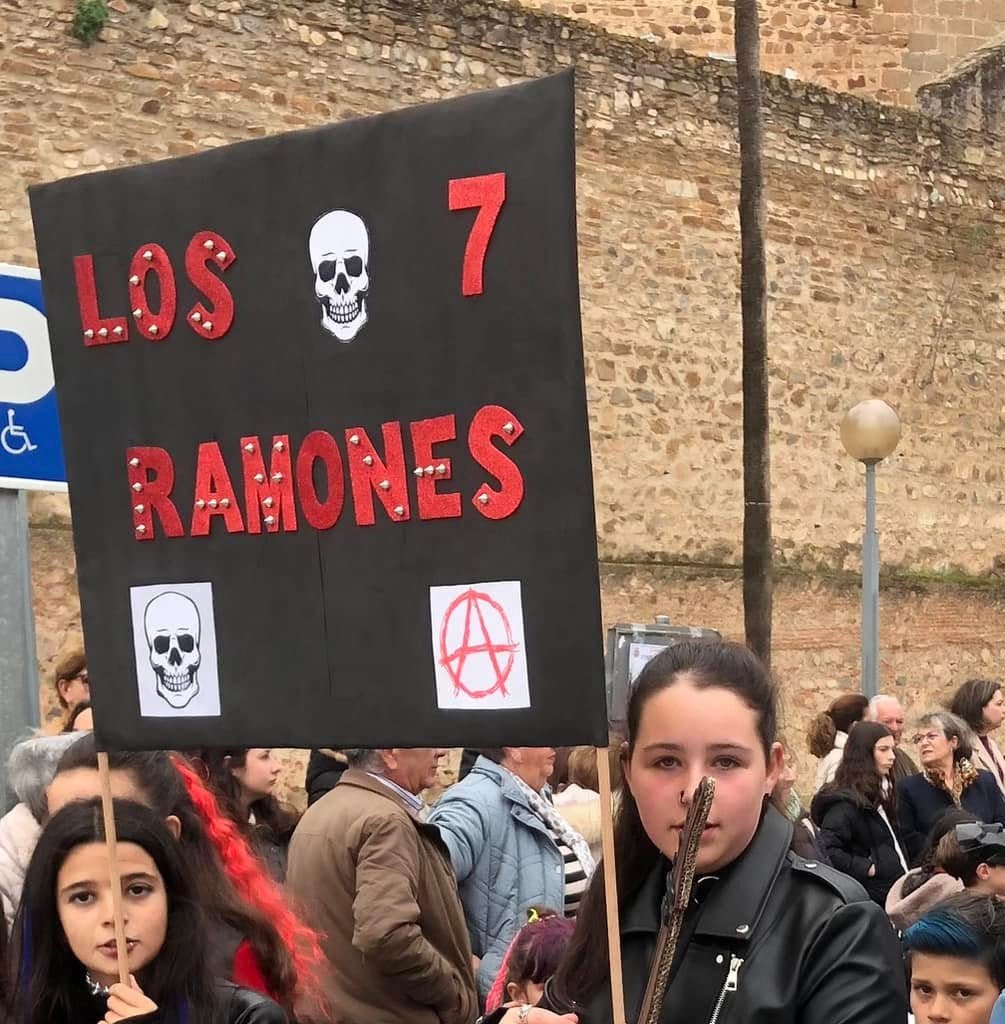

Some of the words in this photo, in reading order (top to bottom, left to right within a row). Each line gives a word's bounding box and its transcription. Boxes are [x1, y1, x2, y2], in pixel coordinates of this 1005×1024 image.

[74, 231, 237, 346] LOS
[448, 172, 507, 296] 7
[126, 405, 525, 540] RAMONES
